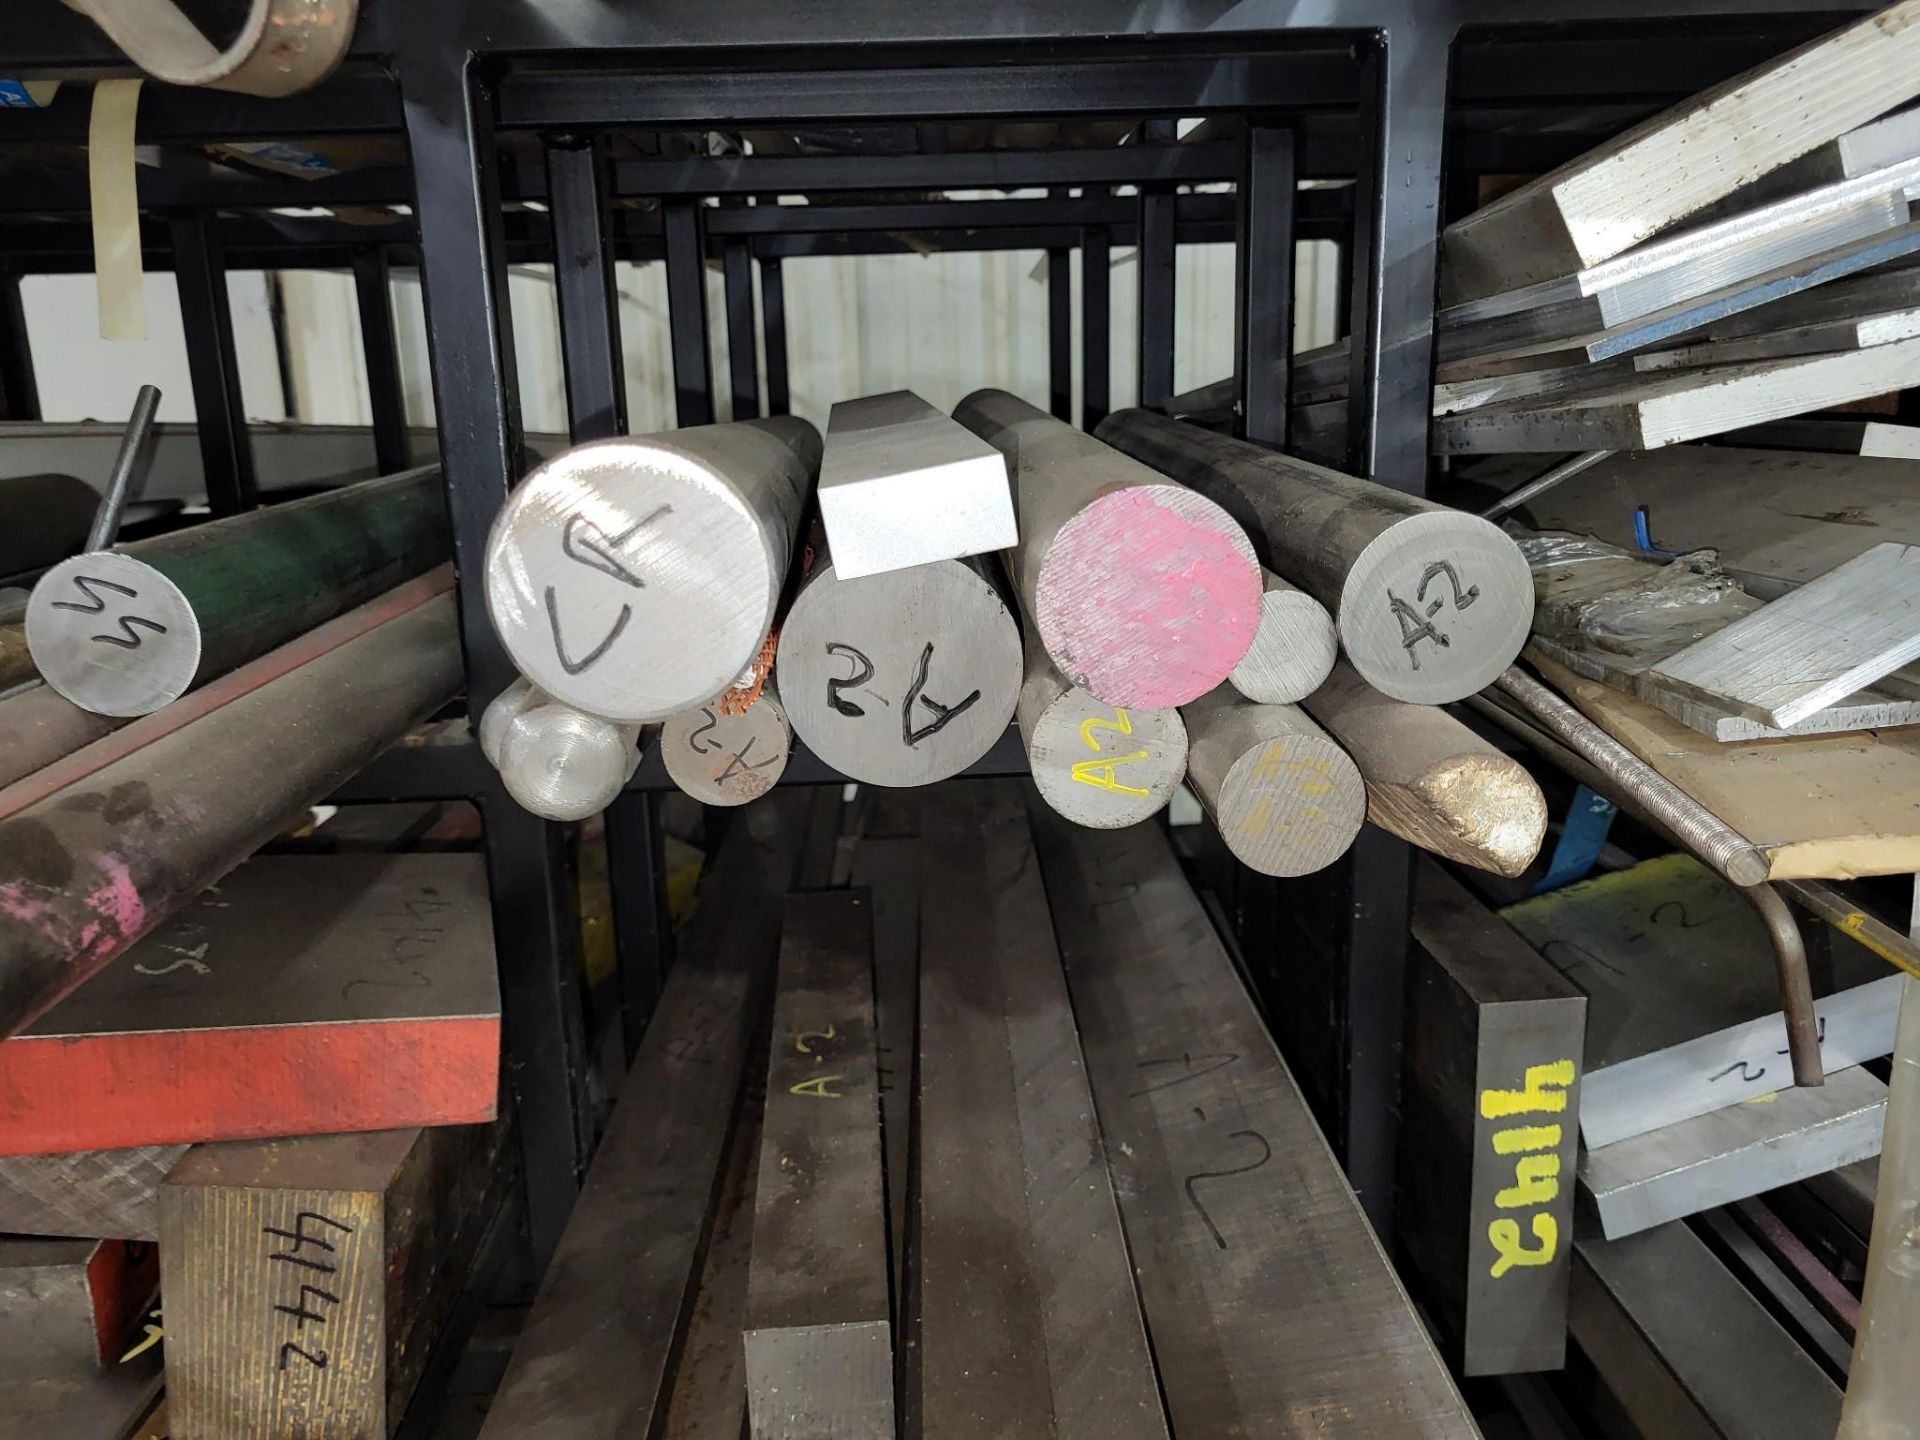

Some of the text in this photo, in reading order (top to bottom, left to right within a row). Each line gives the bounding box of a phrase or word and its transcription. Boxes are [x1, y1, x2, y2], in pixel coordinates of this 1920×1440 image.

[1386, 557, 1482, 671] A-2
[1071, 707, 1151, 799] A2
[789, 1021, 843, 1100] A-2
[1130, 1051, 1273, 1250] A-2
[1480, 1058, 1576, 1281] 4142
[263, 1211, 354, 1372] 4142
